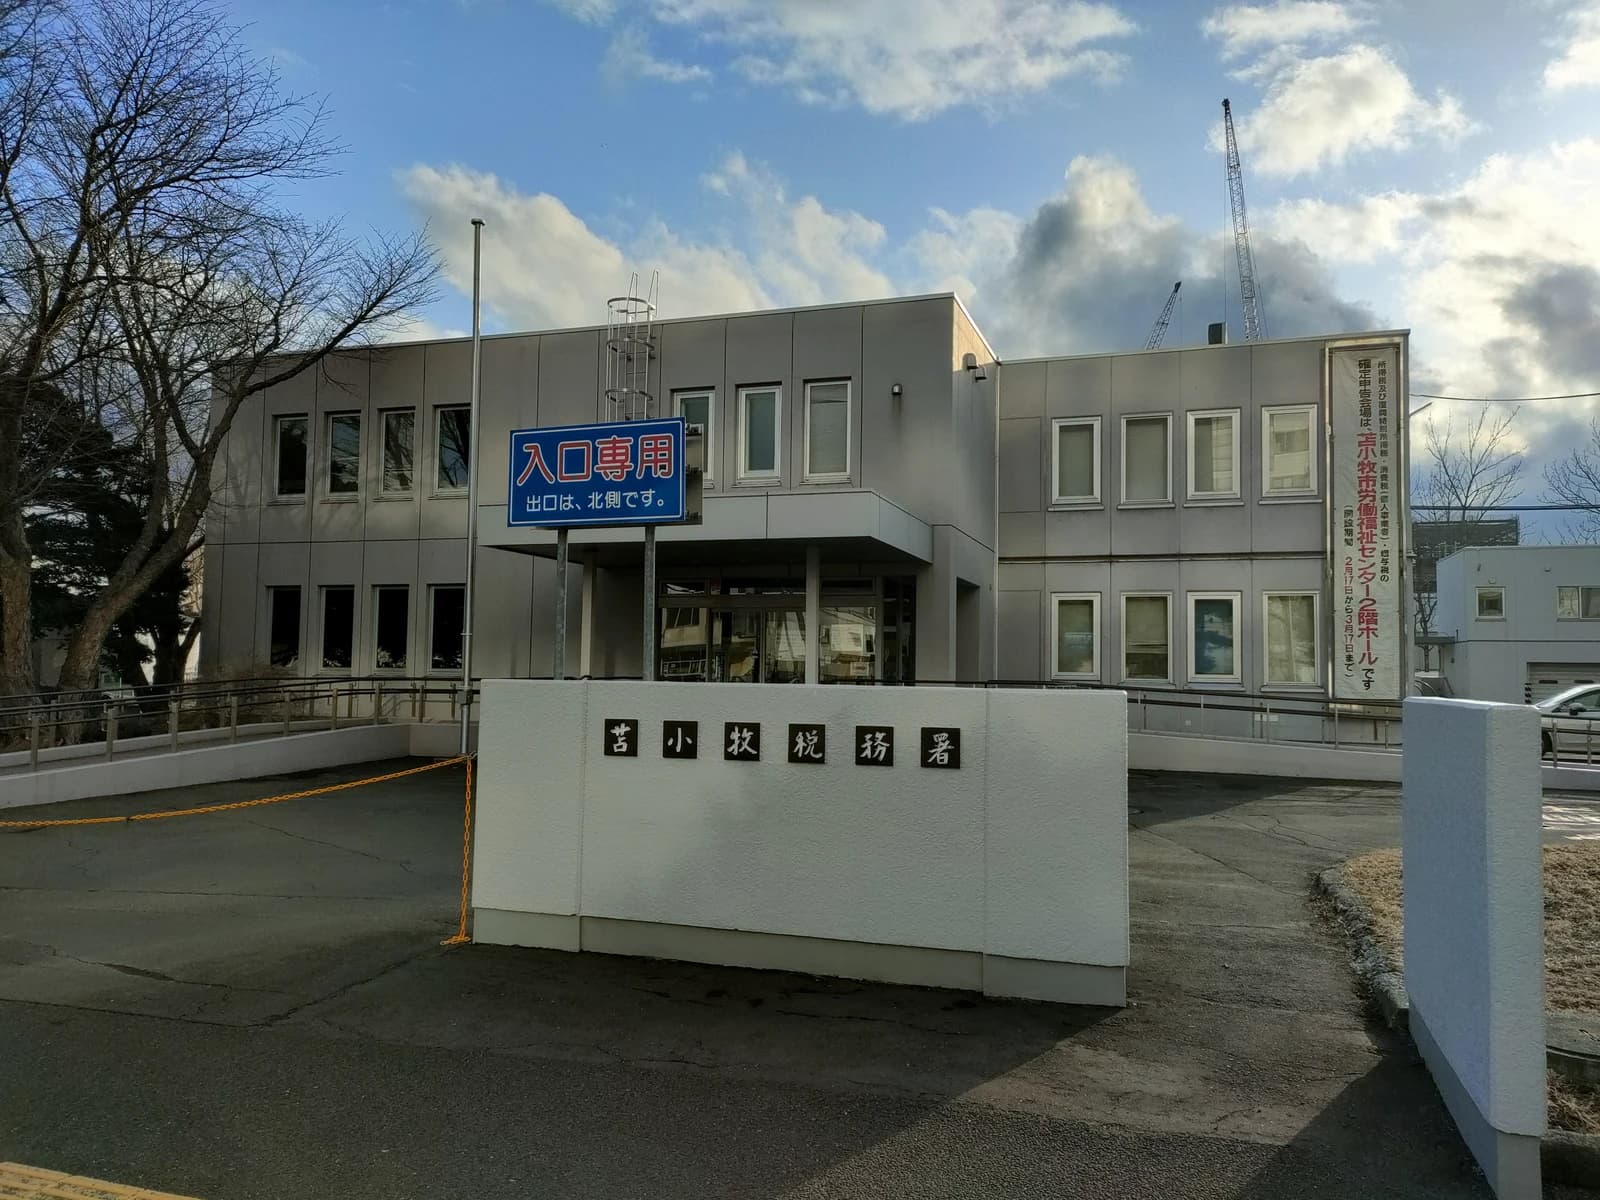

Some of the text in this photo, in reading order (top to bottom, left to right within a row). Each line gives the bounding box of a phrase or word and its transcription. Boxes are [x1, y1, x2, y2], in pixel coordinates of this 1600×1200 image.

[517, 433, 674, 486] 入口専用
[526, 488, 665, 512] 出口は、北側です。
[608, 722, 957, 767] 苫小牧税務署
